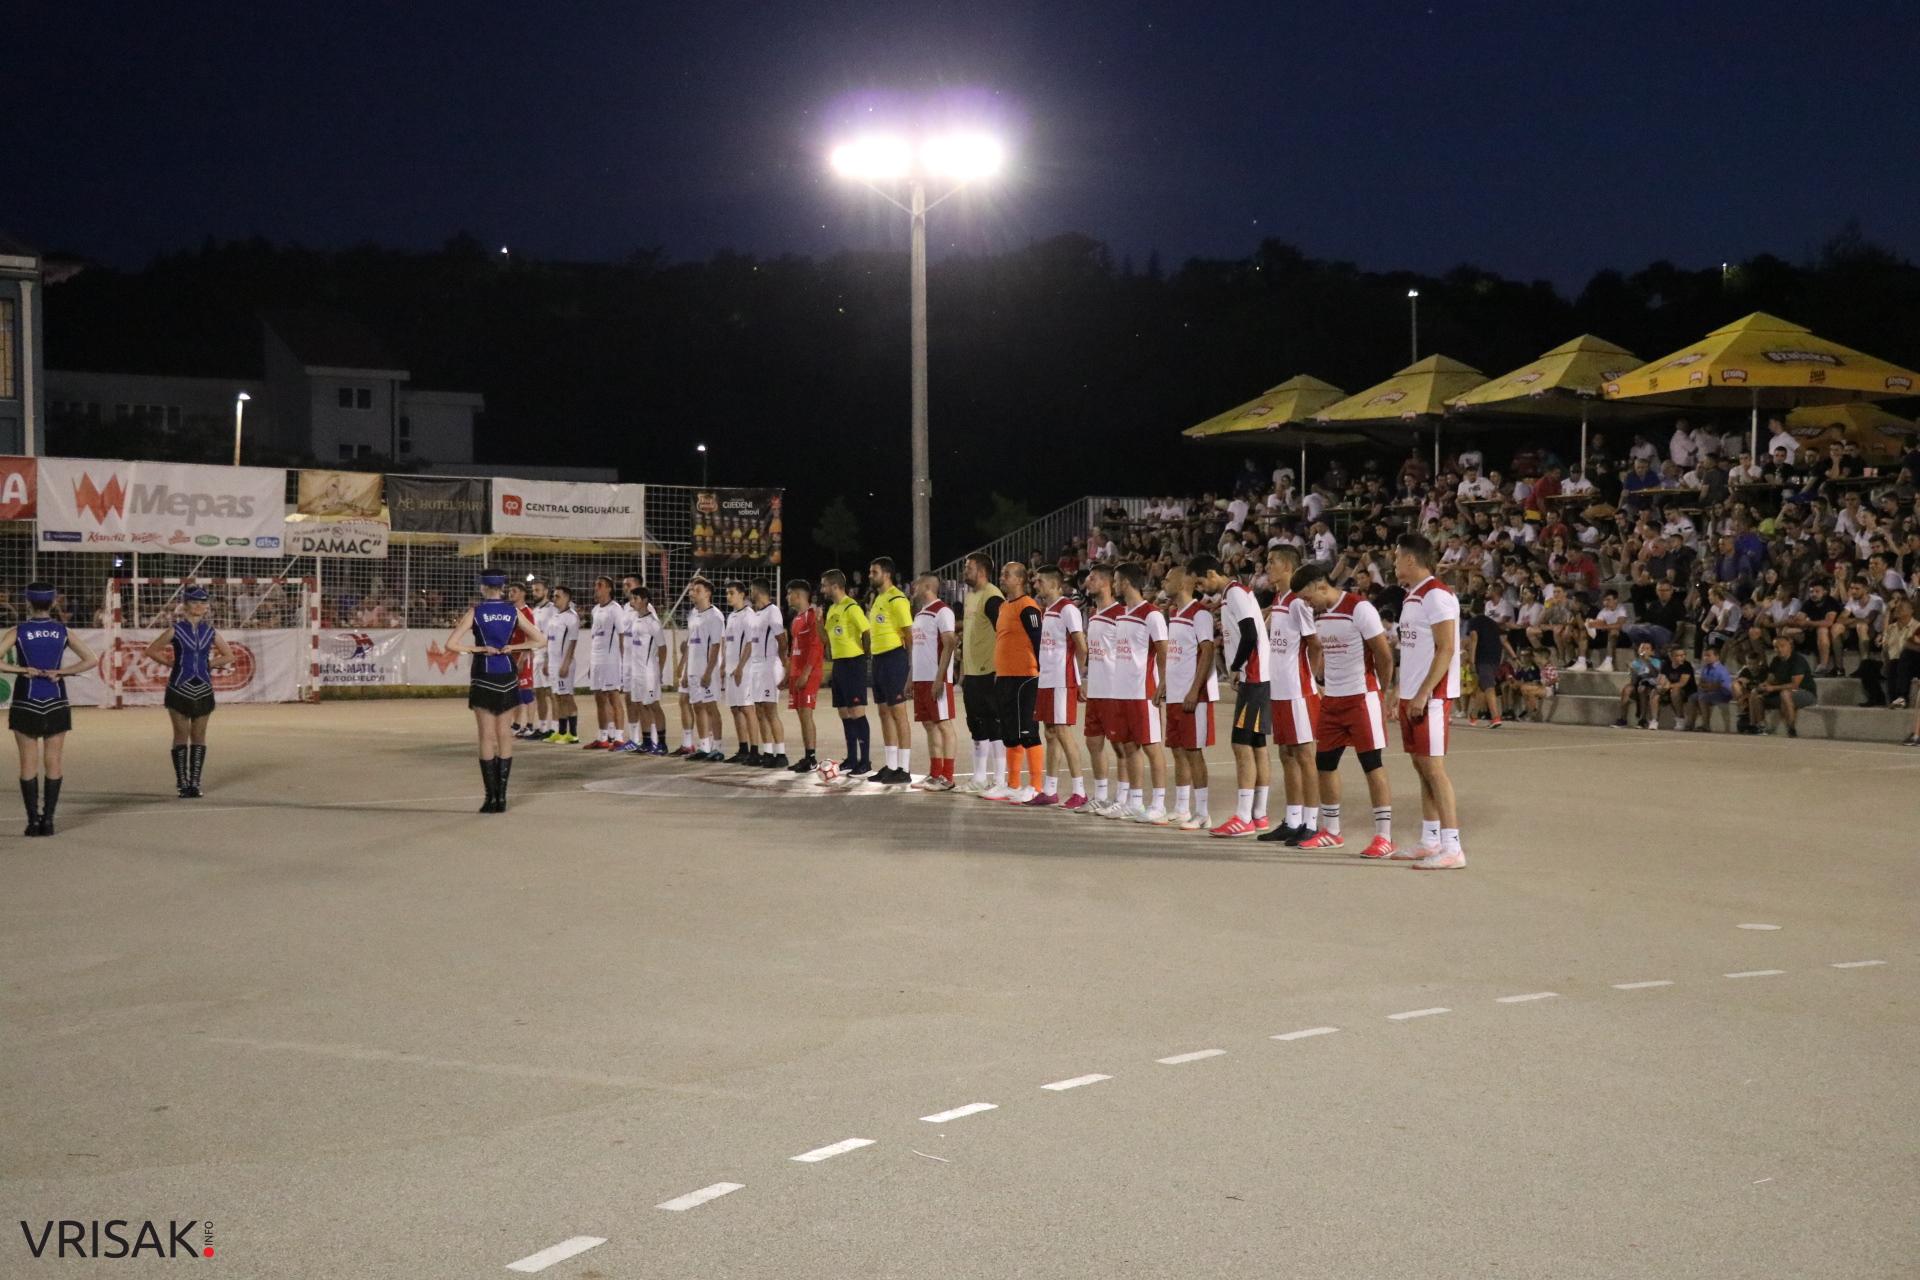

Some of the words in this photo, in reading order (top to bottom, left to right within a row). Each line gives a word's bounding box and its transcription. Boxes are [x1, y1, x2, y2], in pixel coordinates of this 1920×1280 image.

[130, 484, 255, 526] Mepas
[525, 502, 569, 513] CENTRAL
[572, 505, 630, 514] OSIGURANJE
[764, 689, 771, 697] 2
